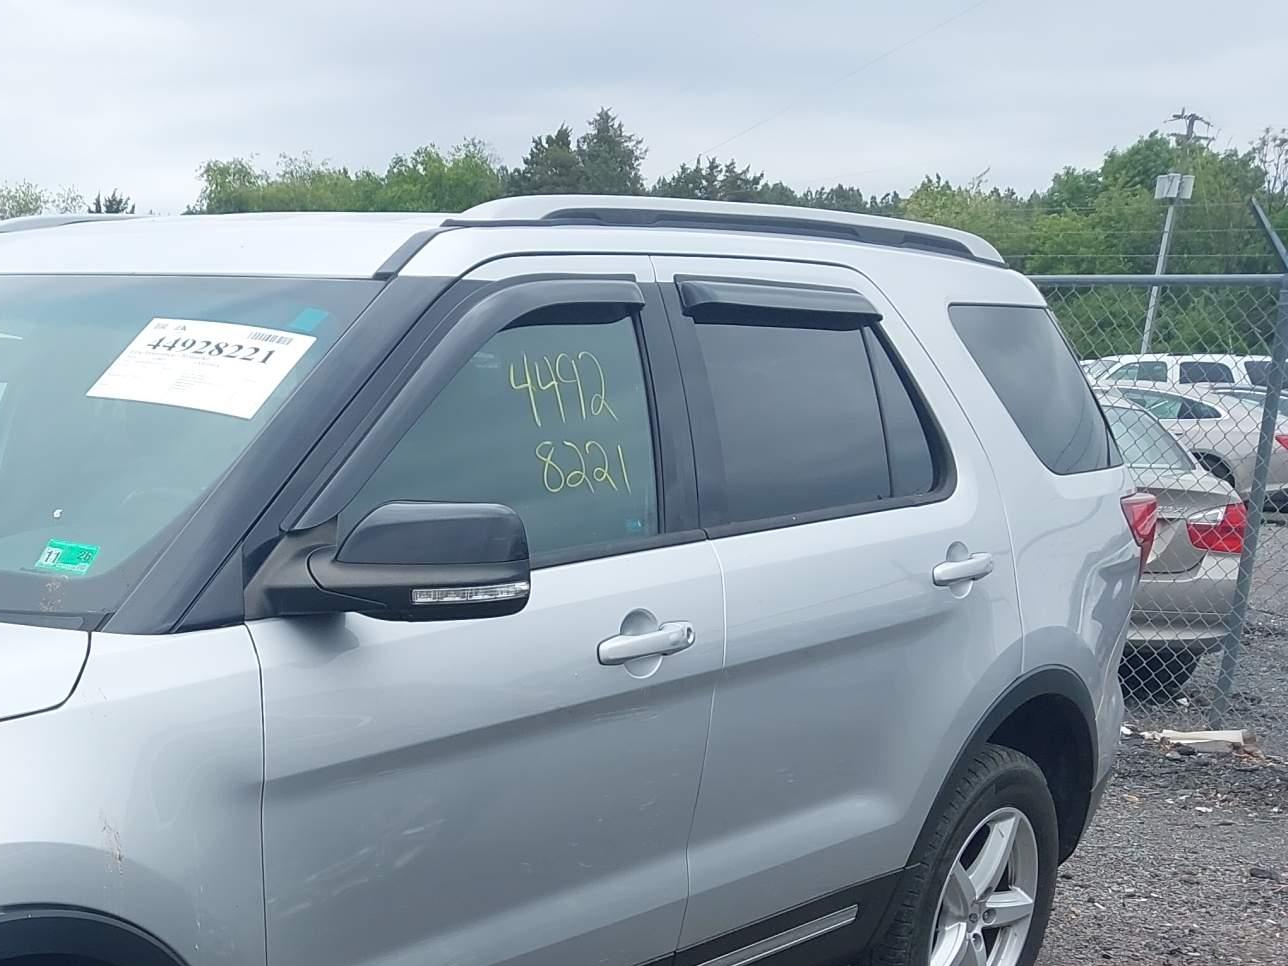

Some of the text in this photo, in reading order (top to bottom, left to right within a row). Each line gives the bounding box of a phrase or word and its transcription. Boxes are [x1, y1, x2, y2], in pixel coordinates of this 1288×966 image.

[147, 335, 276, 365] 44928221
[509, 351, 619, 427] 4492
[535, 440, 632, 494] 8221
[44, 550, 61, 564] 11
